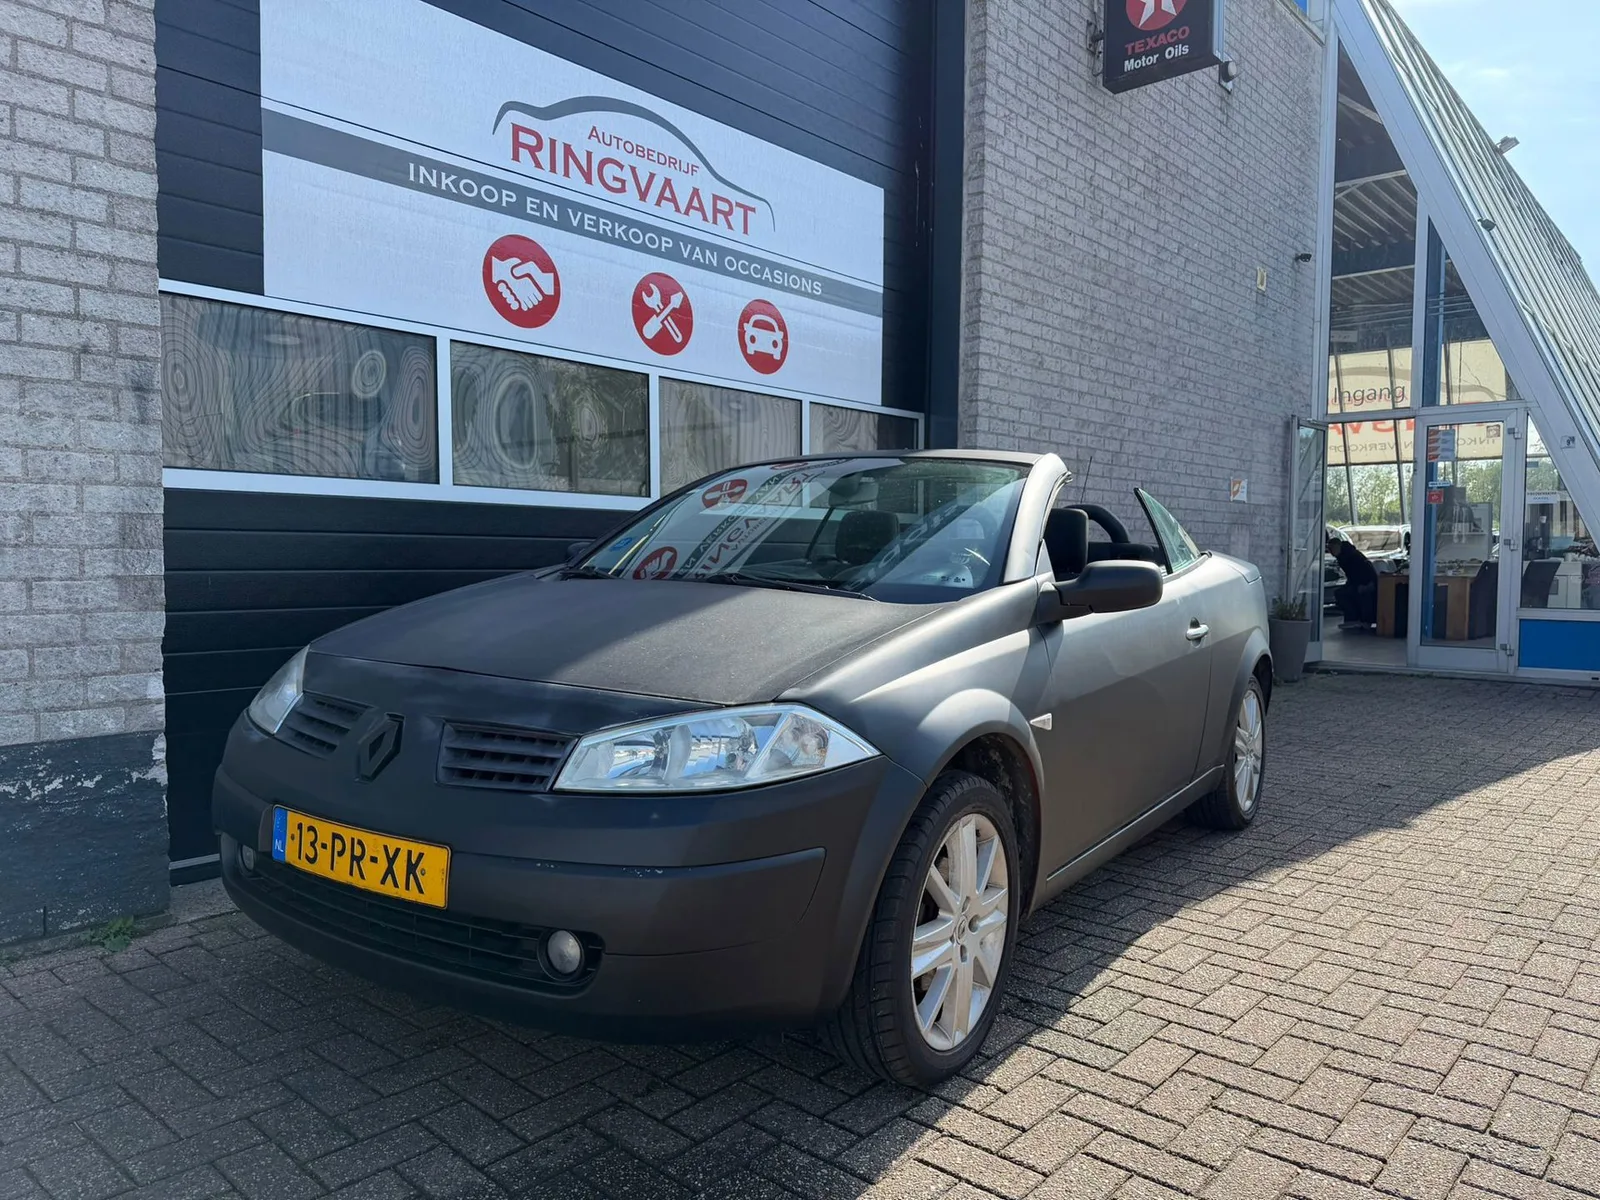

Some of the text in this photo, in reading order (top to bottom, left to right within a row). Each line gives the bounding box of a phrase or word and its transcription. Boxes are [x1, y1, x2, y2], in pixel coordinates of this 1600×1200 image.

[1124, 44, 1189, 72] Motor Oils
[1125, 26, 1190, 55] TEXACO
[588, 126, 699, 177] AUTOBEDRIJF
[511, 123, 756, 236] RINGVAART
[408, 163, 822, 295] INKOOP EN VERKOOP VAN OCCASIONS
[1334, 386, 1405, 406] Ingang
[274, 838, 284, 852] NL
[297, 822, 425, 895] 13-PR-XK
